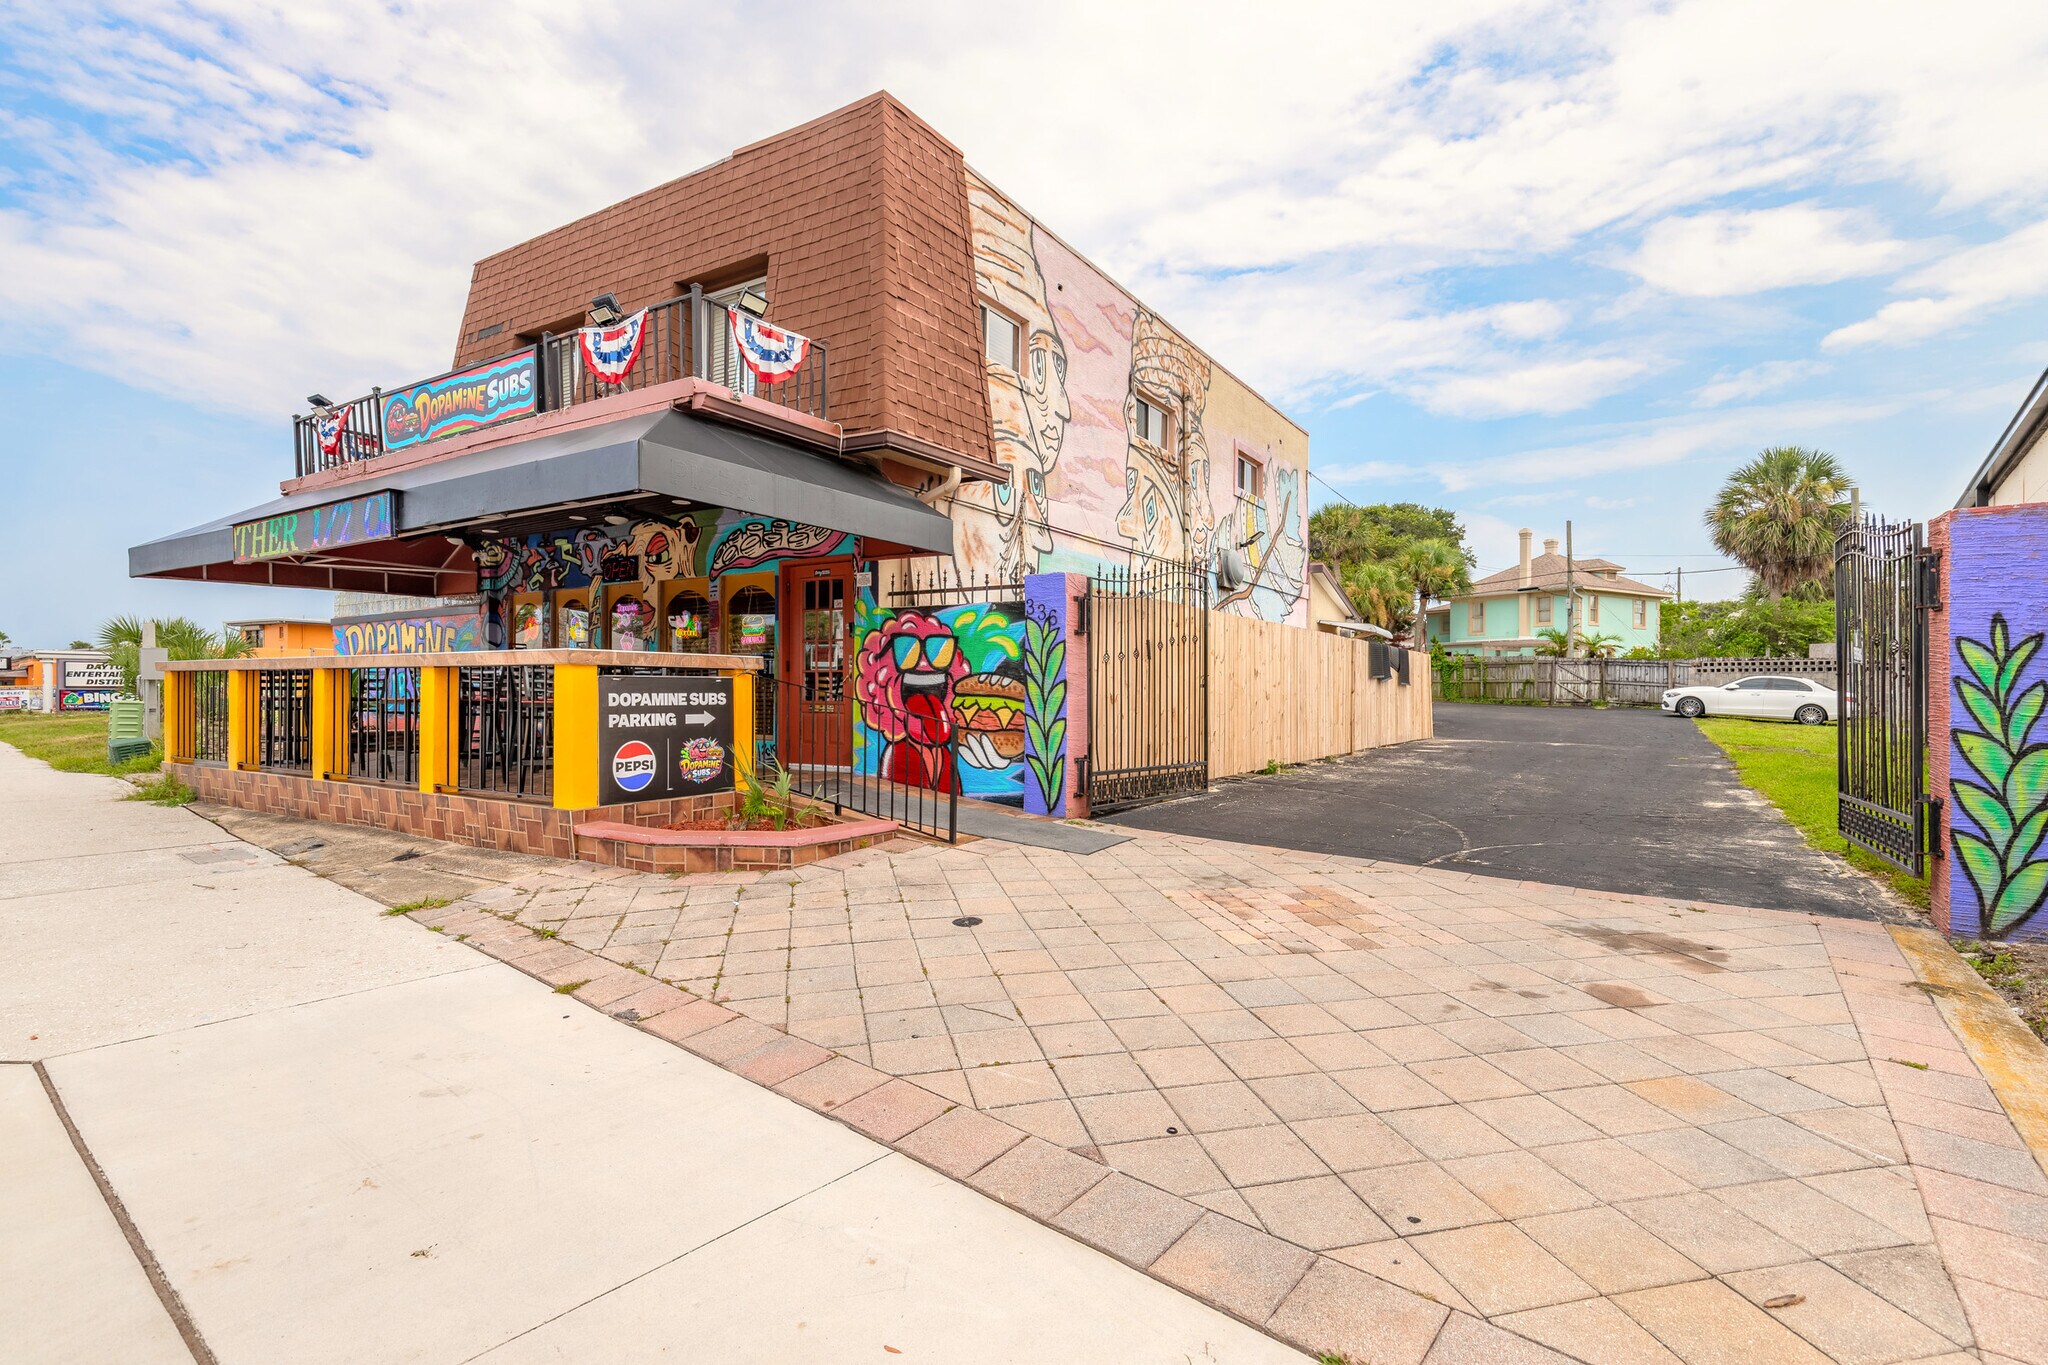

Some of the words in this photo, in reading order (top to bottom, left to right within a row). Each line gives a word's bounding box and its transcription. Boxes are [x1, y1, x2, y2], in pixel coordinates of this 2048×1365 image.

[487, 369, 531, 408] SUBS
[234, 514, 299, 562] THER
[603, 560, 635, 578] OPEN
[1026, 598, 1058, 626] 336
[608, 692, 688, 707] DOPAMINE
[689, 692, 727, 706] SUBS
[608, 712, 677, 728] PARKING
[615, 759, 654, 773] PEPSI
[692, 768, 712, 779] SUBS
